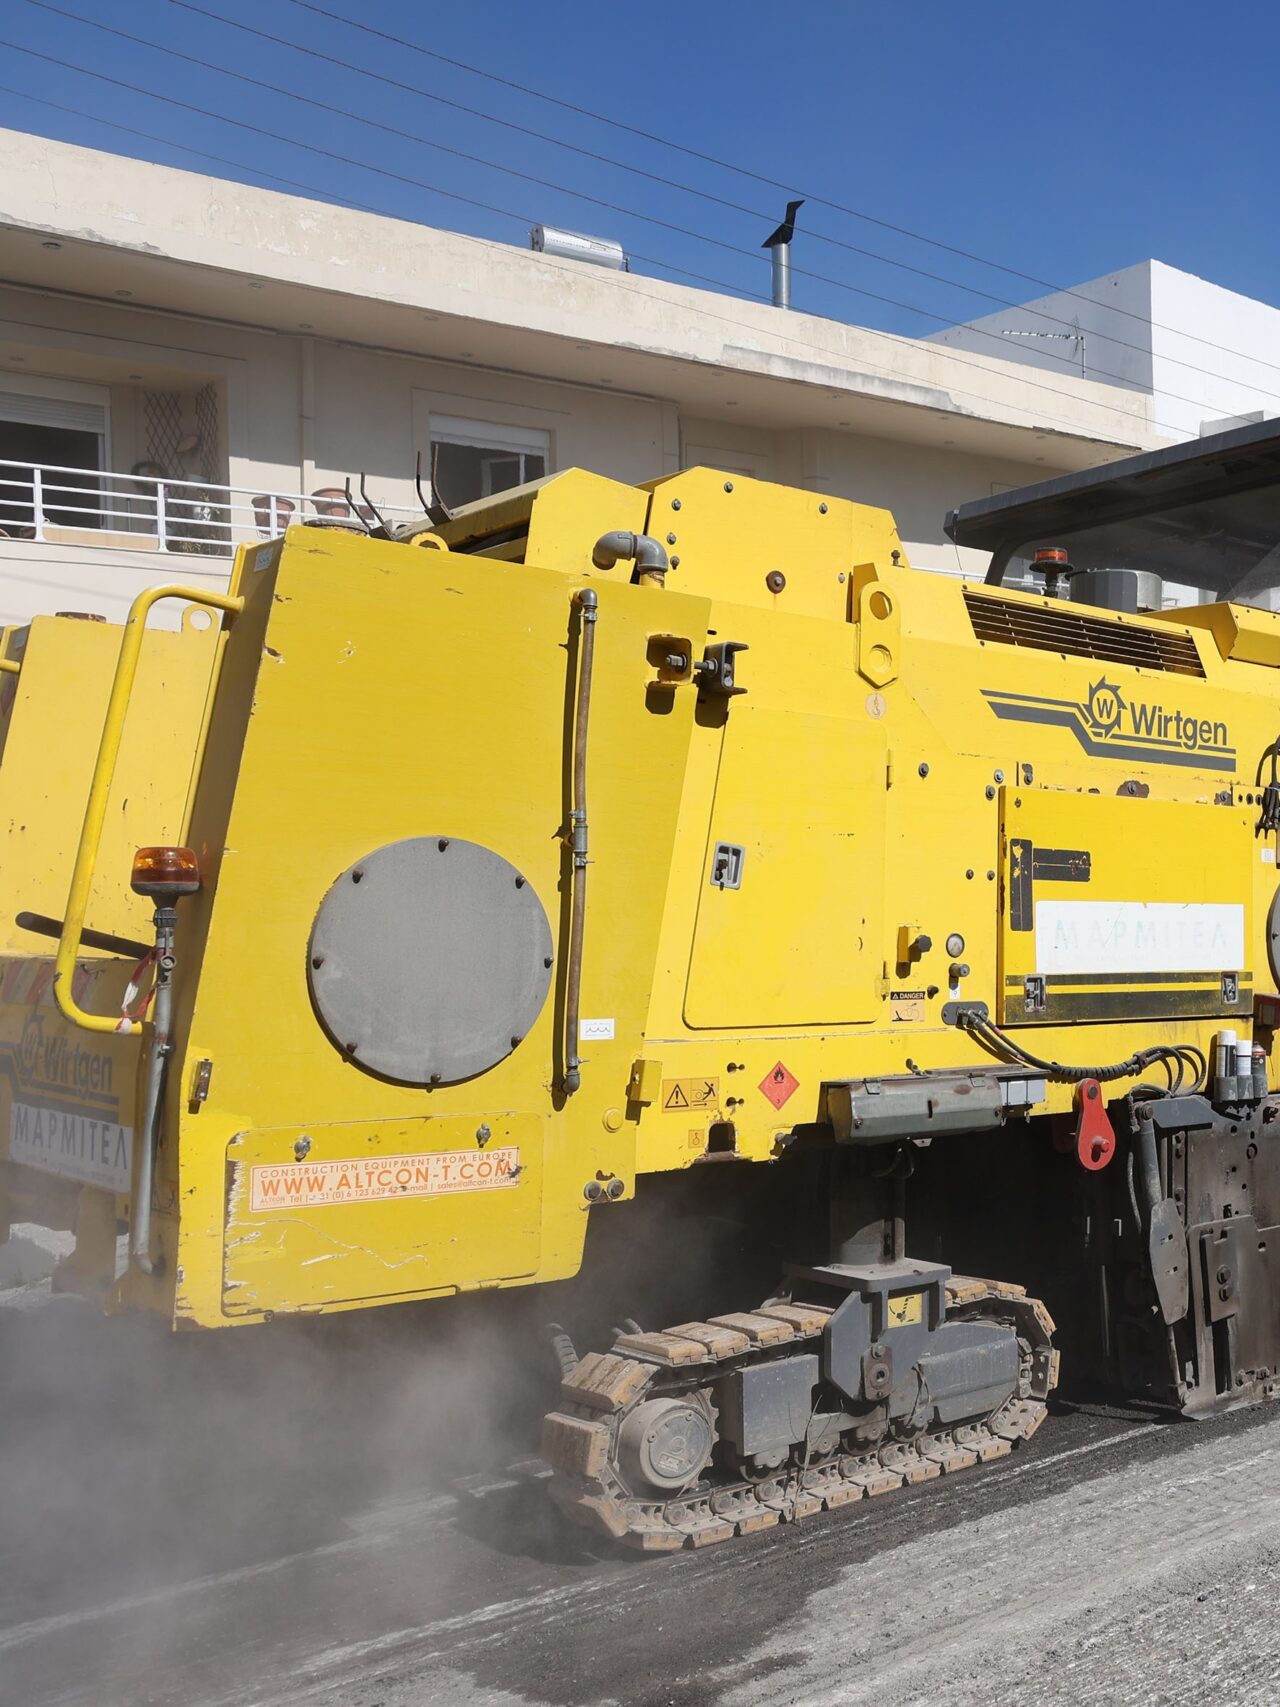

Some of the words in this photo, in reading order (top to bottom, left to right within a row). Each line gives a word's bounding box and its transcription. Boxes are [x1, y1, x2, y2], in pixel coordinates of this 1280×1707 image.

[1096, 697, 1114, 719] W
[1130, 702, 1227, 750] Wirtgen
[900, 992, 924, 1000] DANGER
[45, 1036, 113, 1099] Wirtgen
[260, 1163, 358, 1179] CONSTRUCTION
[364, 1158, 430, 1171] EQUIPMENT
[436, 1154, 467, 1165] FROM
[472, 1151, 512, 1162] EUROPE
[261, 1160, 511, 1197] WWW.ALTCON-T.COM
[290, 1194, 303, 1203] Tel
[332, 1191, 344, 1200] (0)
[355, 1188, 369, 1197] 123
[371, 1186, 385, 1195] 629
[400, 1183, 428, 1193] -mail
